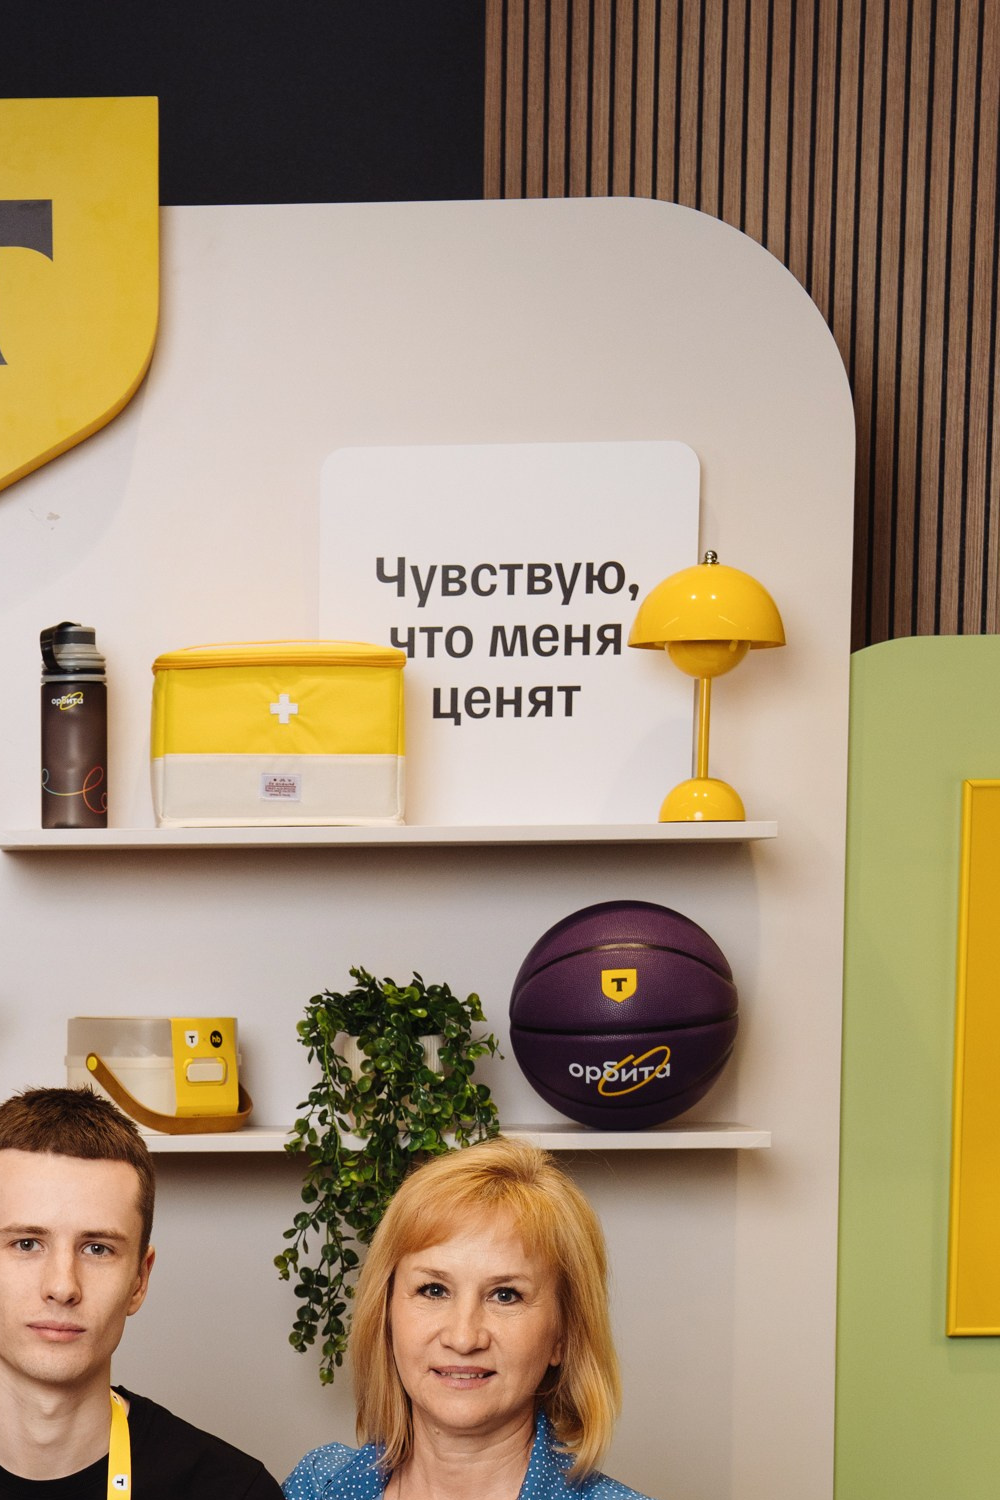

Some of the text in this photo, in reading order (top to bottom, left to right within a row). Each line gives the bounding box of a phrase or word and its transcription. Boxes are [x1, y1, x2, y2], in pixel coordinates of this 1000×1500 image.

[376, 556, 639, 608] Чувствую,
[390, 623, 622, 659] что меня
[51, 694, 84, 707] орбита
[432, 685, 581, 726] ценят
[568, 1060, 671, 1084] орбита
